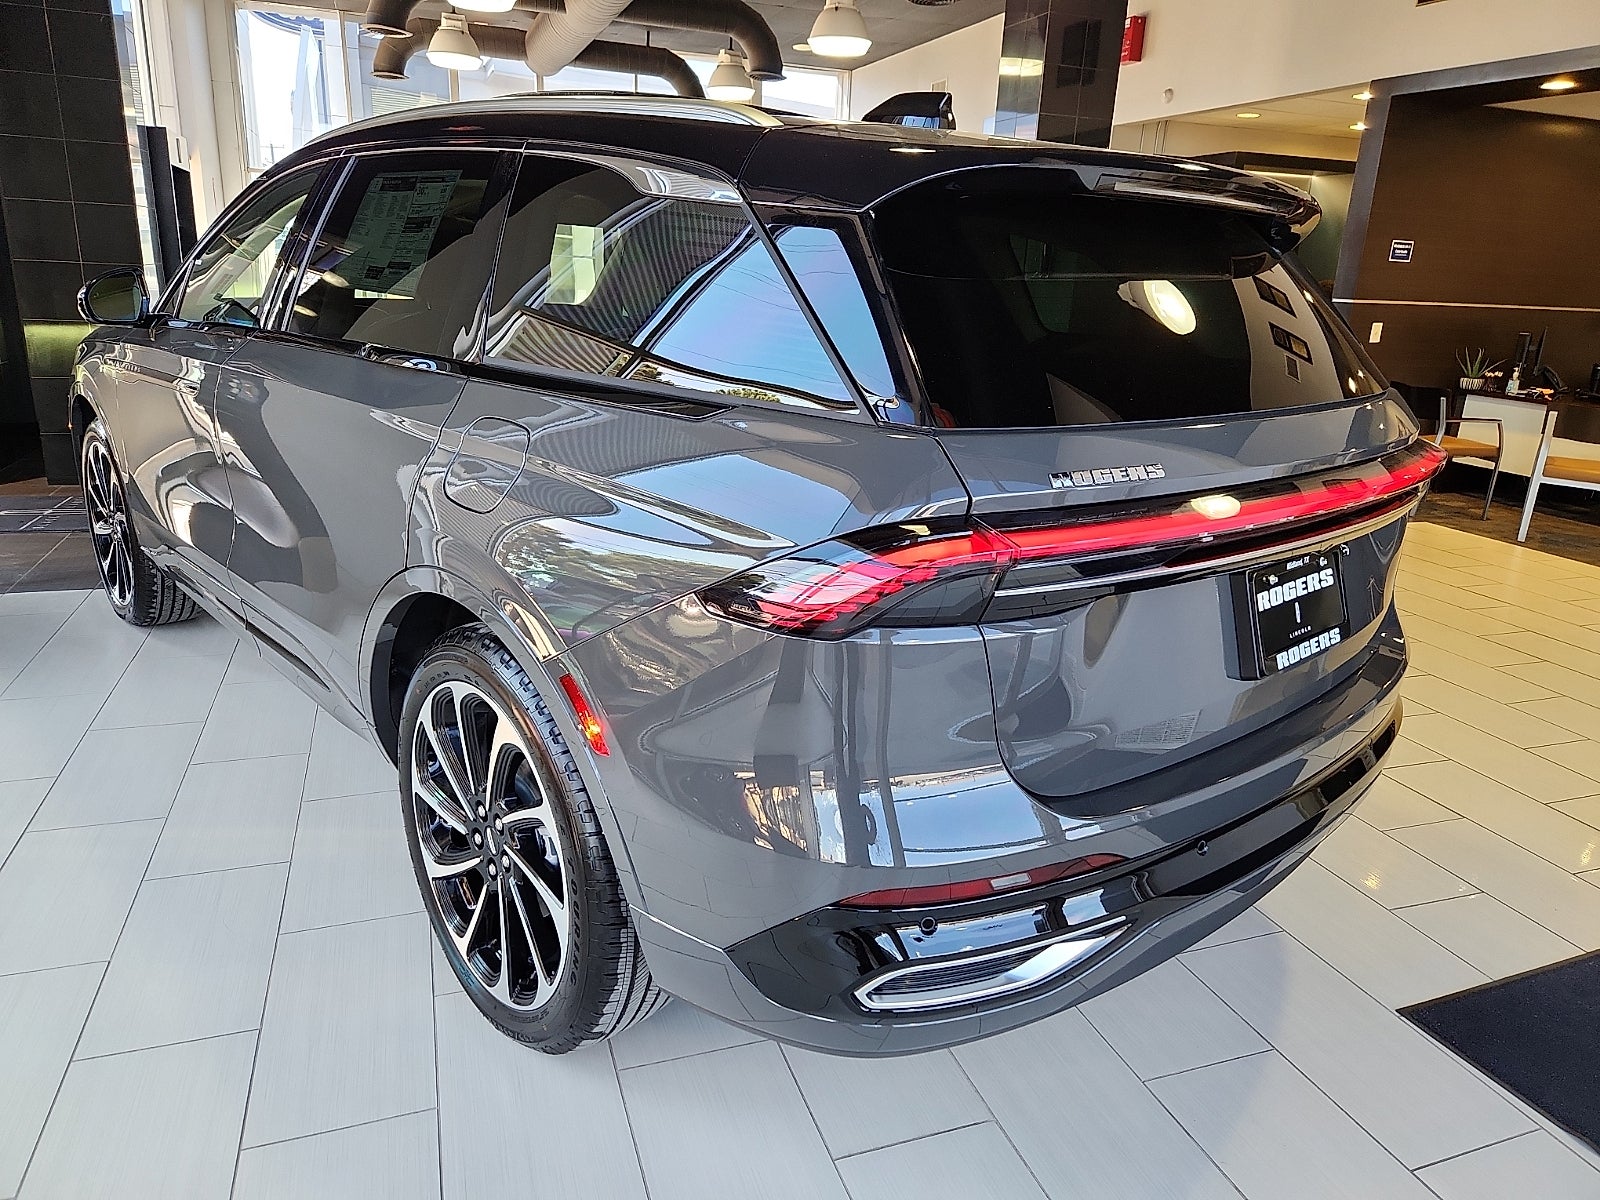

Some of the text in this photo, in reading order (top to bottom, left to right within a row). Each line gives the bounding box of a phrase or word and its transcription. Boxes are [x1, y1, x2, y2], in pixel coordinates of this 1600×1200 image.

[1048, 463, 1166, 489] ROGERS
[1257, 567, 1335, 612] ROGERS
[1276, 627, 1341, 671] ROGERS
[1289, 625, 1312, 639] LINCOLN
